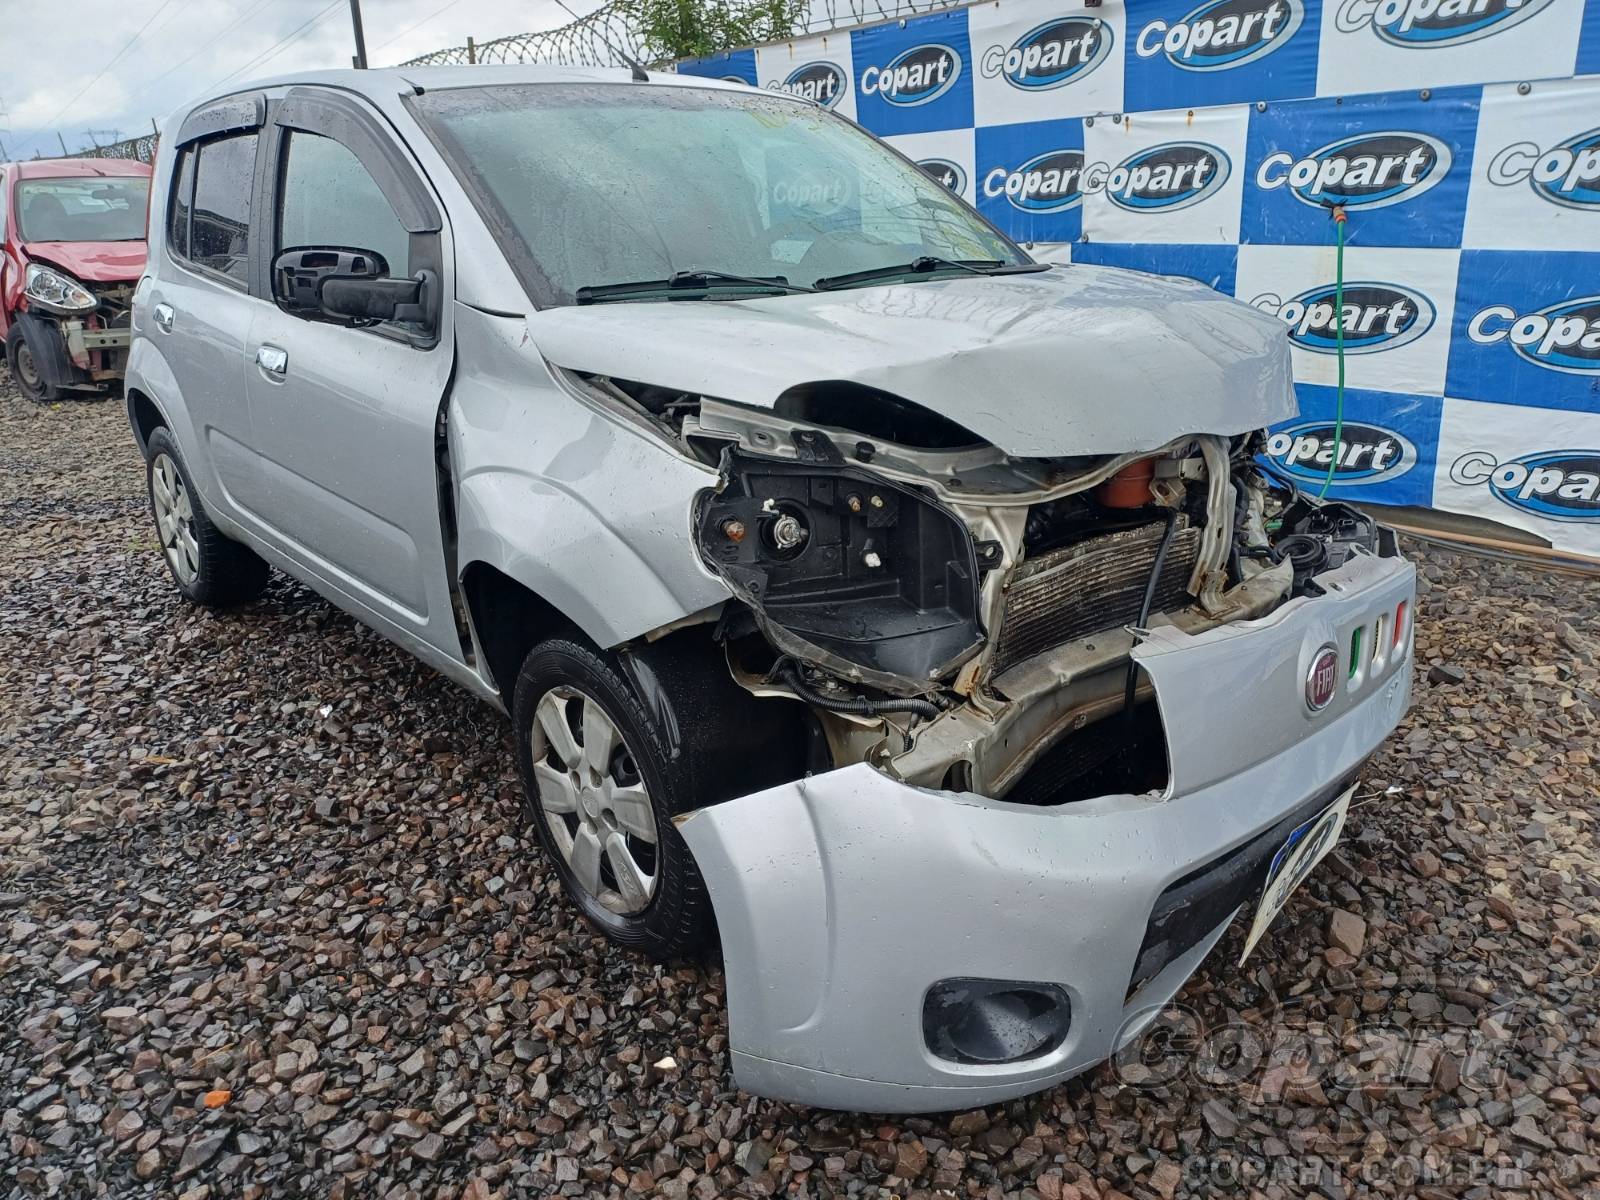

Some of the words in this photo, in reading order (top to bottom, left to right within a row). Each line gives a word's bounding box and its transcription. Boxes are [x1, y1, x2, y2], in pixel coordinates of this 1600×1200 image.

[1136, 3, 1281, 58] Copart
[1335, 0, 1522, 33] Copa
[861, 53, 949, 97] Copart
[981, 29, 1095, 79] Copart
[984, 161, 1085, 201] Copar
[1081, 155, 1209, 199] Copart
[1256, 143, 1426, 194] Copart
[1487, 141, 1600, 192] Cop
[1467, 304, 1600, 356] Cop
[1266, 432, 1393, 470] opart
[1450, 451, 1600, 501] Copa
[1316, 662, 1335, 697] FIAT
